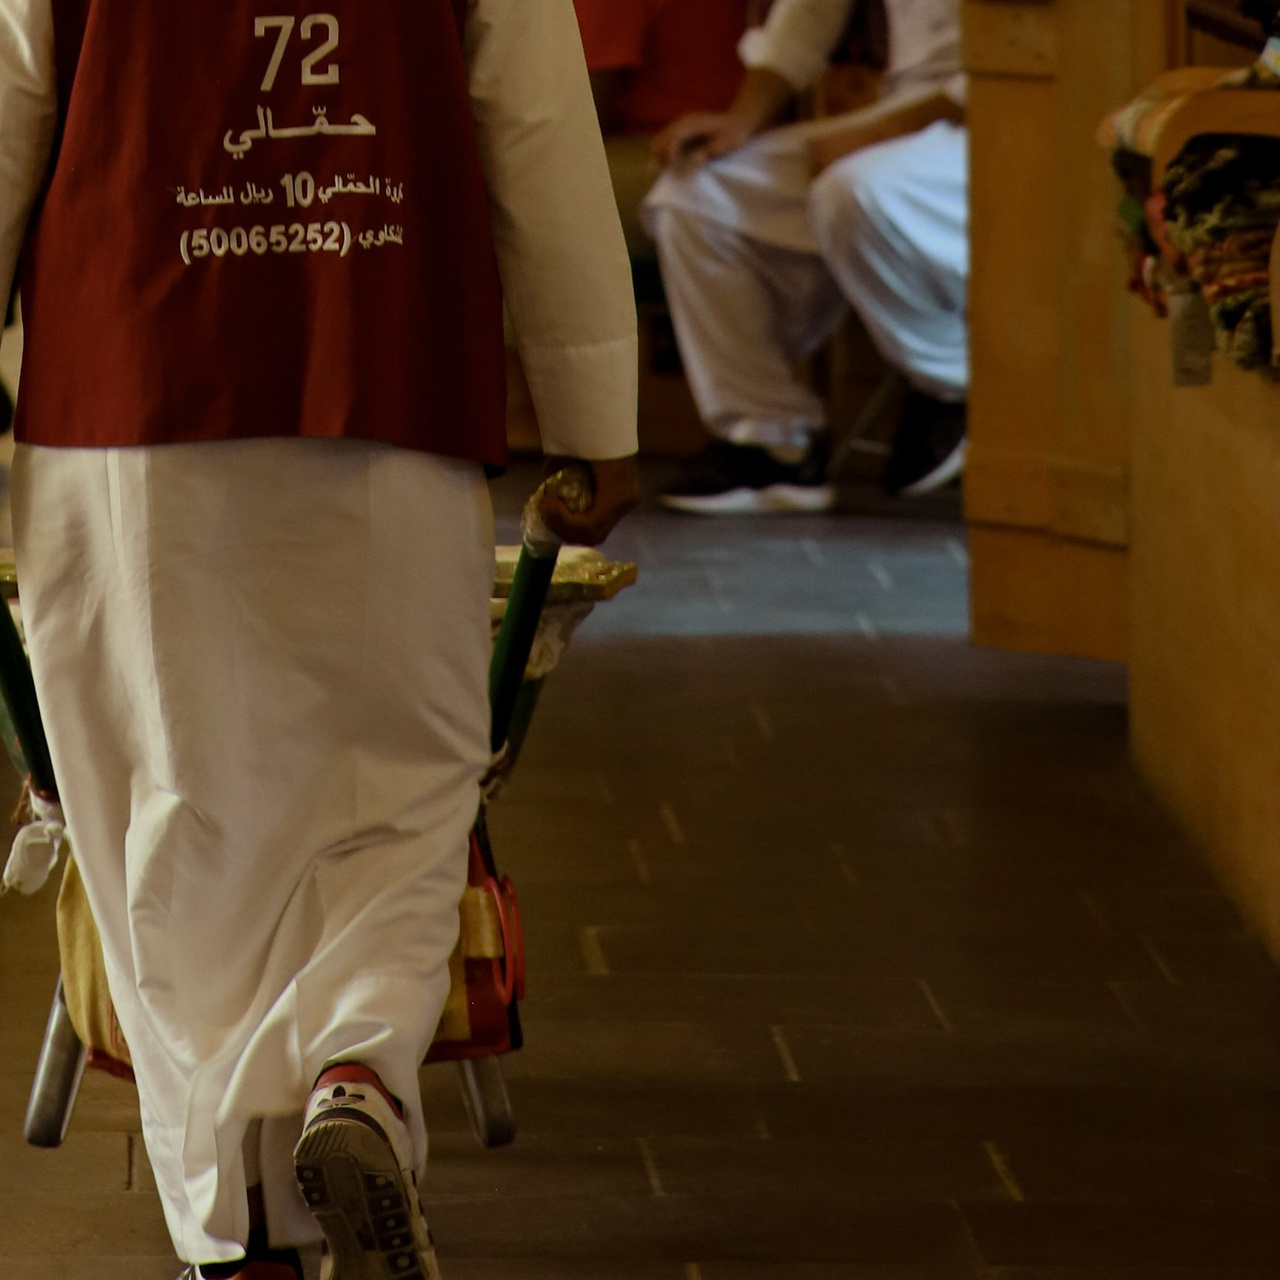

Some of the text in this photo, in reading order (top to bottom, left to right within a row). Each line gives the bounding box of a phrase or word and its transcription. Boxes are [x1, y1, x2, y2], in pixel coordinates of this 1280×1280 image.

[254, 12, 340, 92] 72
[176, 185, 235, 208] للساعة
[239, 181, 274, 205] ريال
[280, 170, 315, 208] 10
[179, 220, 352, 266] (50065252)
